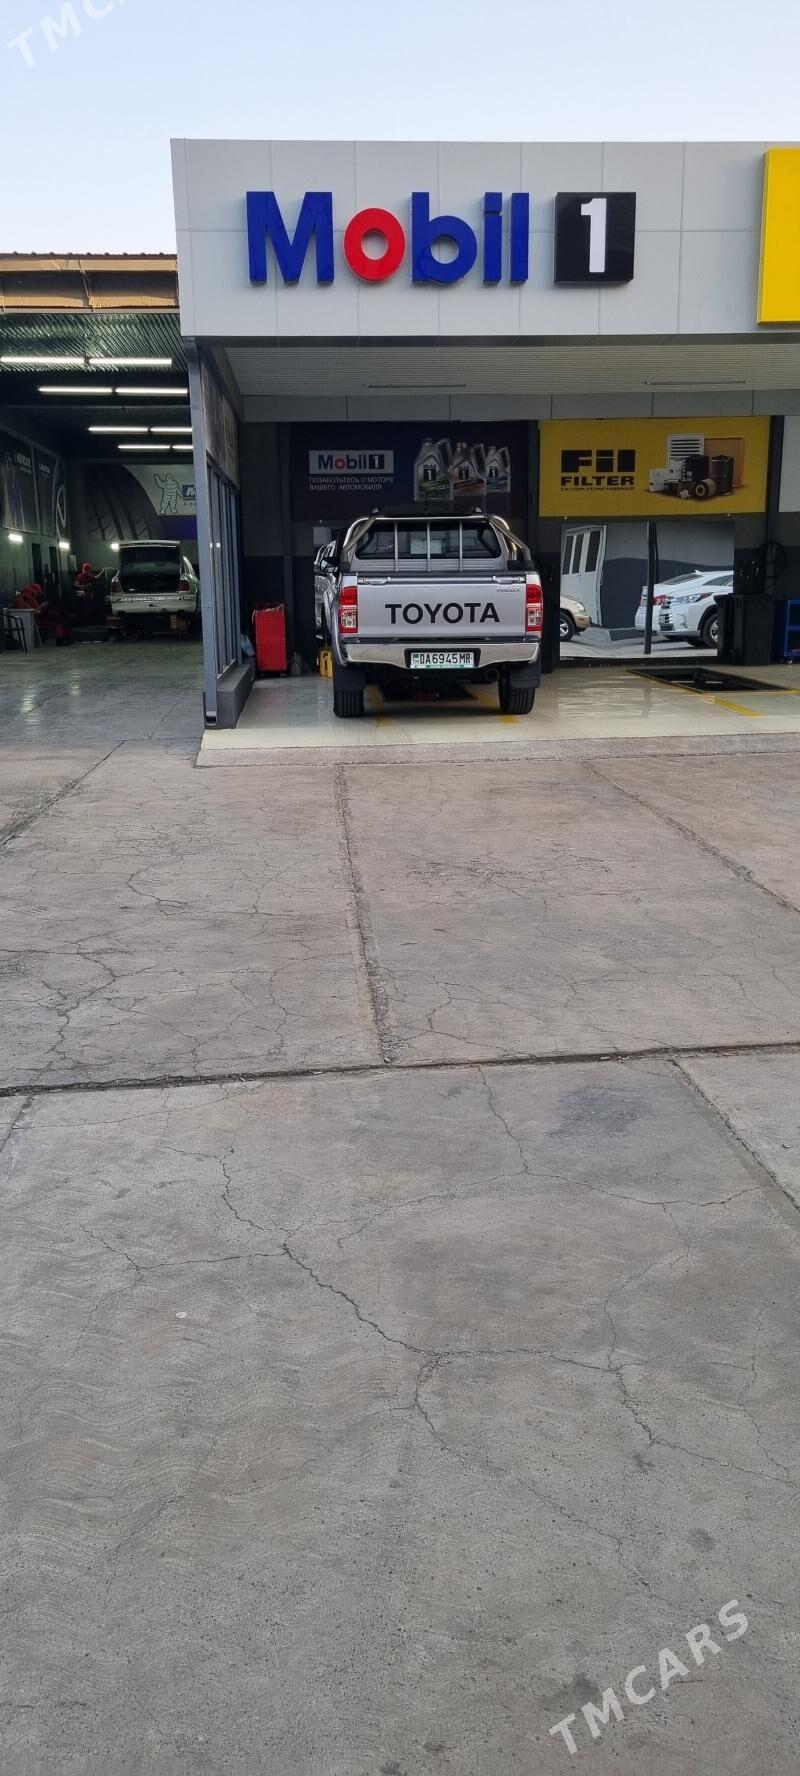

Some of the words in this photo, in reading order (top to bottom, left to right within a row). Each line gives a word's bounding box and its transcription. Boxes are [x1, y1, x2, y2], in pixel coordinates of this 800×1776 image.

[246, 191, 529, 284] Mobil
[317, 454, 367, 470] Mobil
[561, 476, 635, 486] FILTER
[385, 603, 500, 624] TOYOTA
